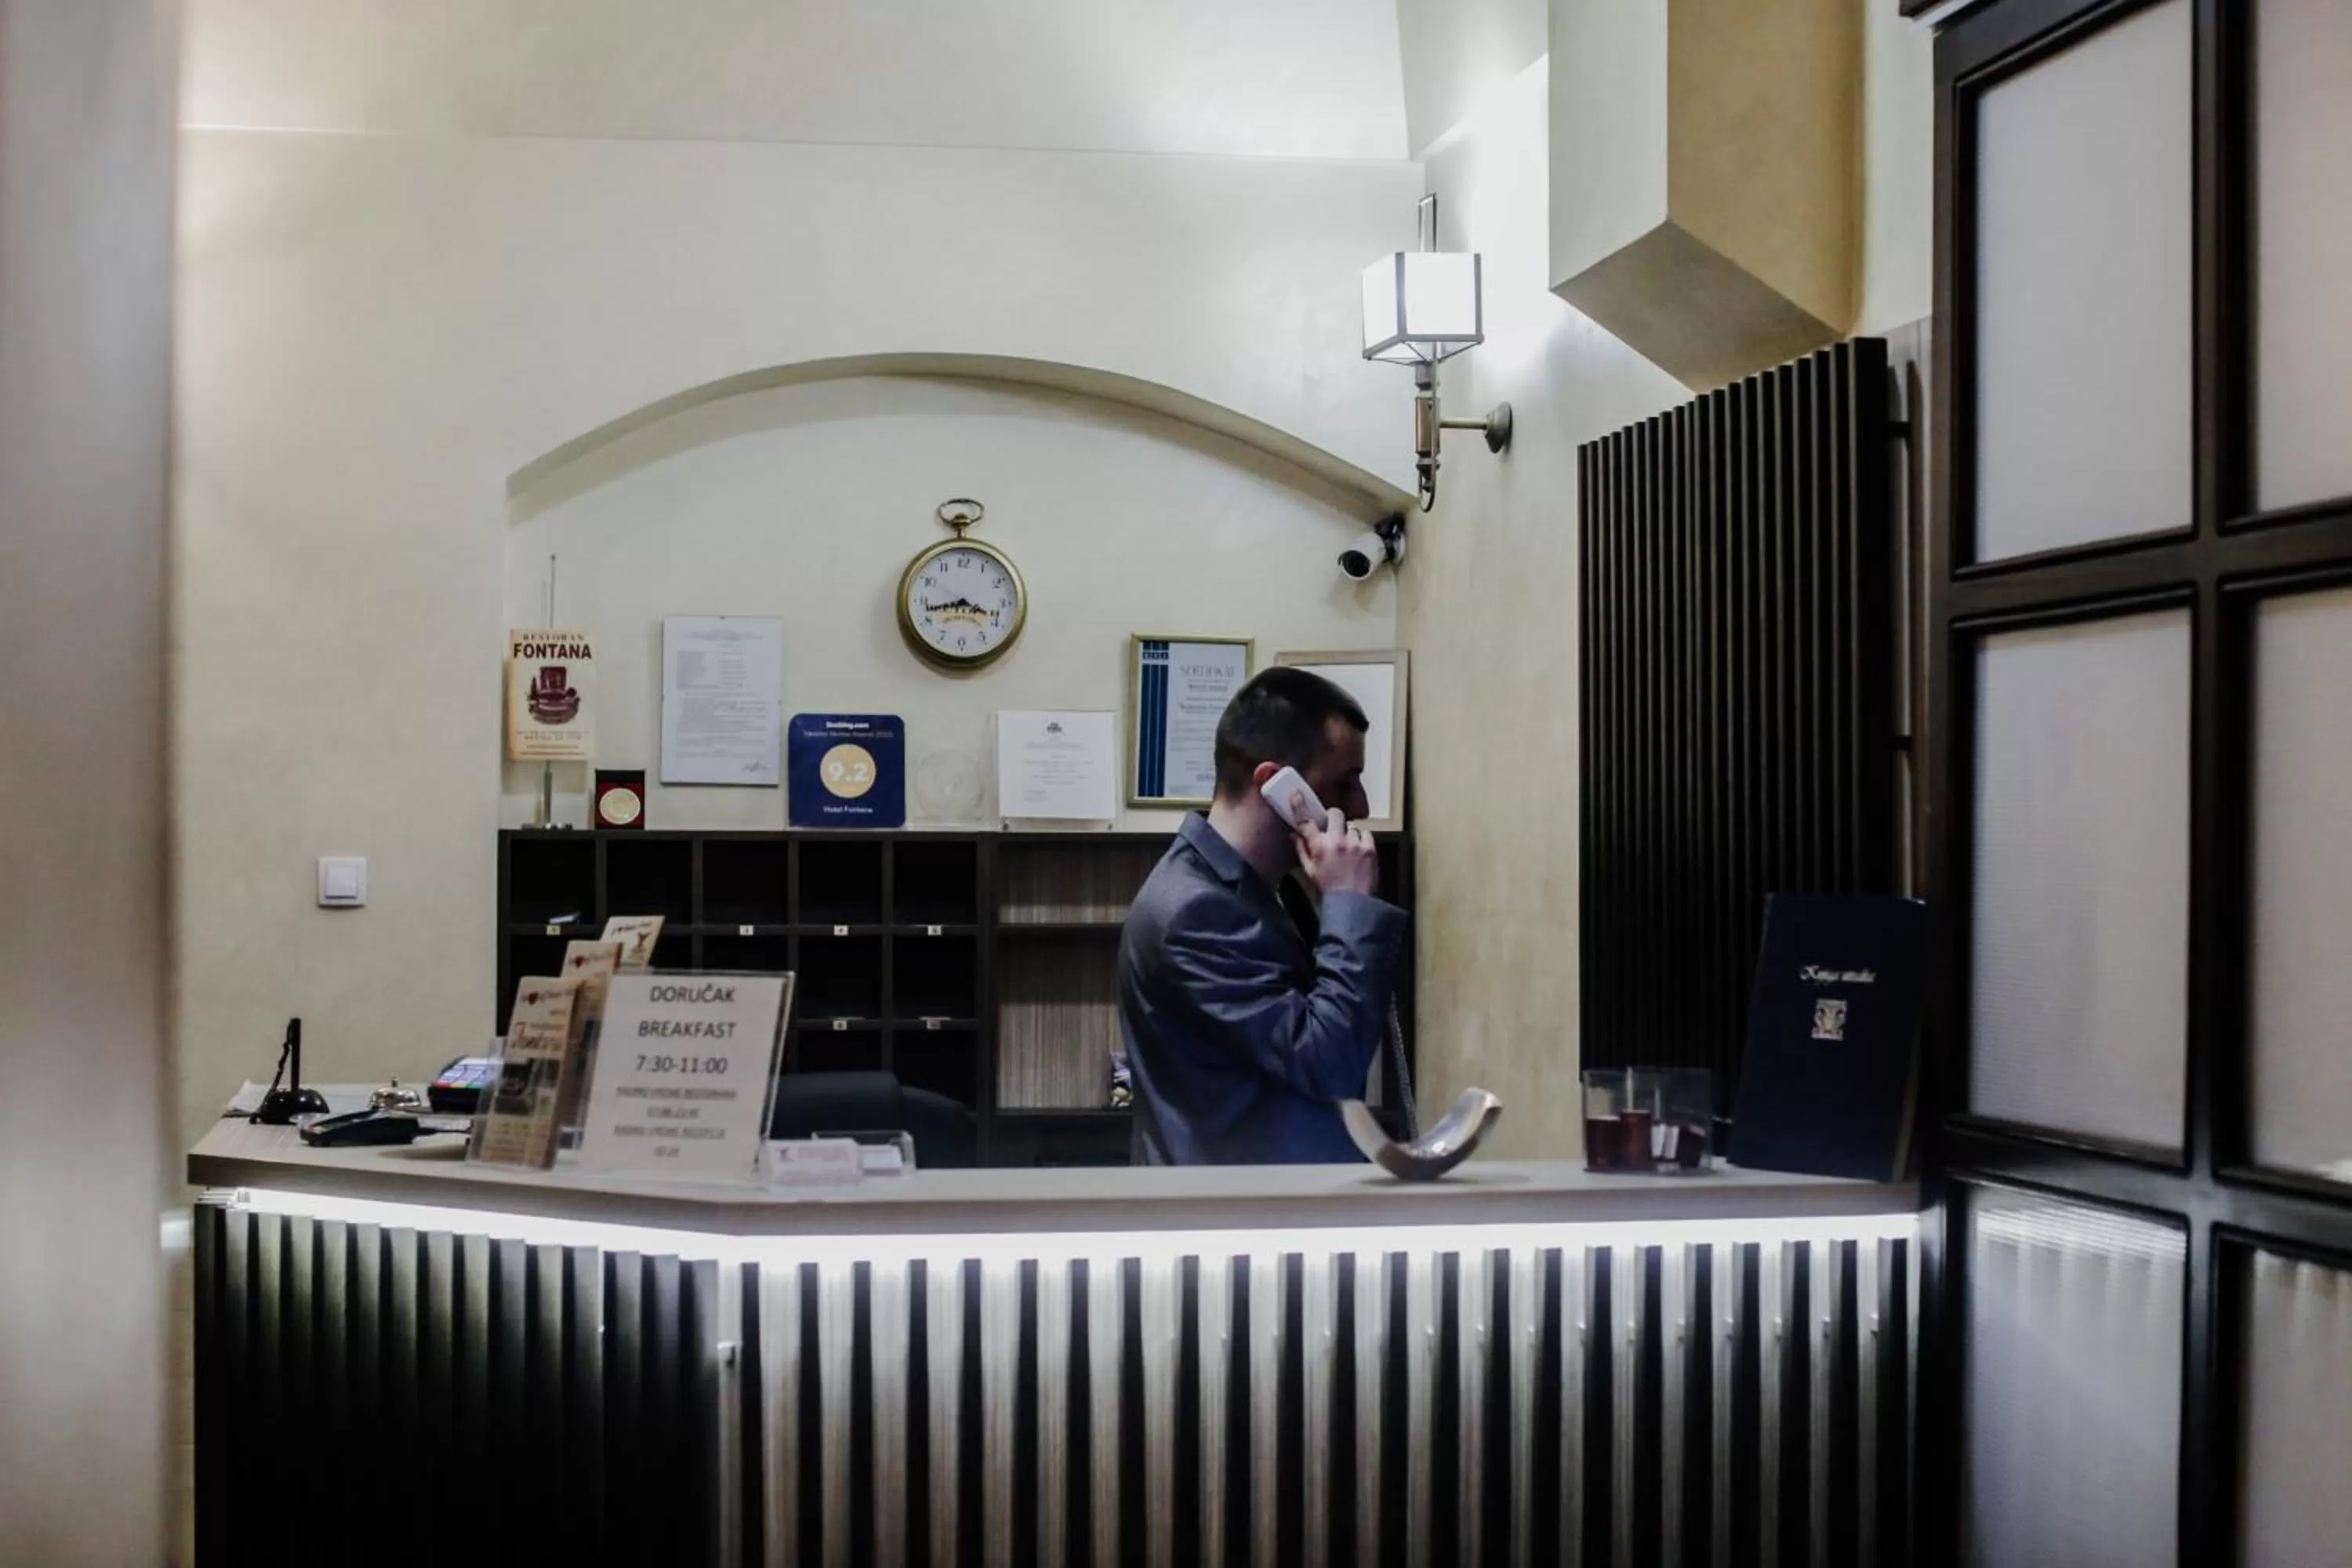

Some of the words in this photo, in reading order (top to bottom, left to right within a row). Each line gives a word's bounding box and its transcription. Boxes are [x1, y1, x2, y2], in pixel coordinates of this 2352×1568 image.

[957, 557, 971, 568] 12
[514, 643, 592, 659] FONTANA
[828, 762, 869, 782] 9.2
[649, 983, 737, 1003] DORUČAK
[637, 1020, 738, 1039] BREAKFAST
[635, 1054, 728, 1074] 7:30-11:00
